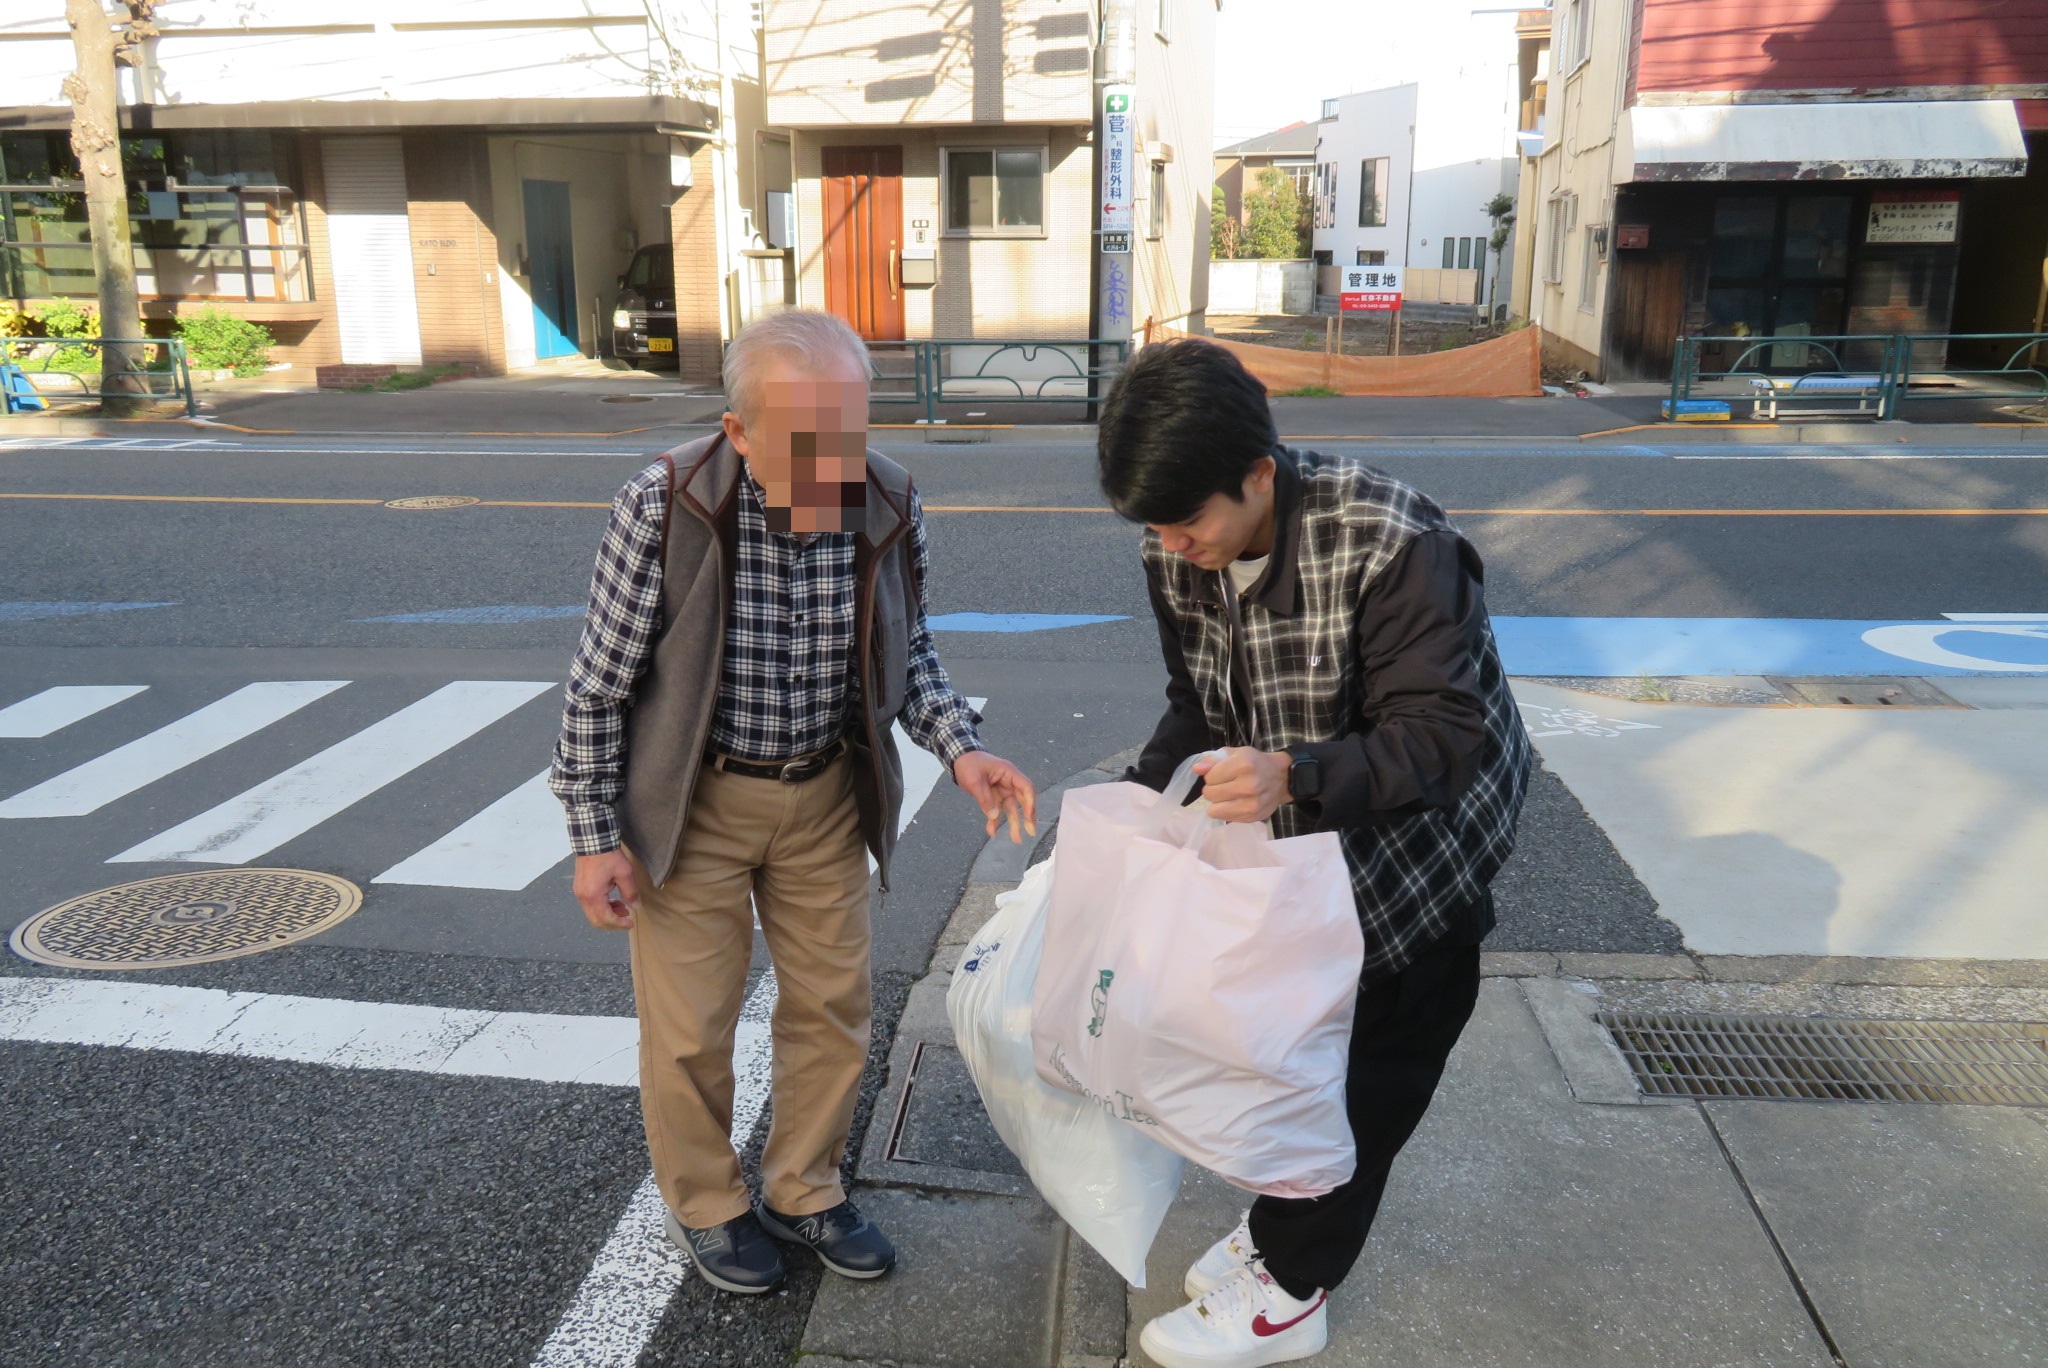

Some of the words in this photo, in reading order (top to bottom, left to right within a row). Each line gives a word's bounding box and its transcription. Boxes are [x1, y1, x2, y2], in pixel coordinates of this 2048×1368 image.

[419, 239, 438, 247] KATO
[1348, 273, 1397, 288] 管理地
